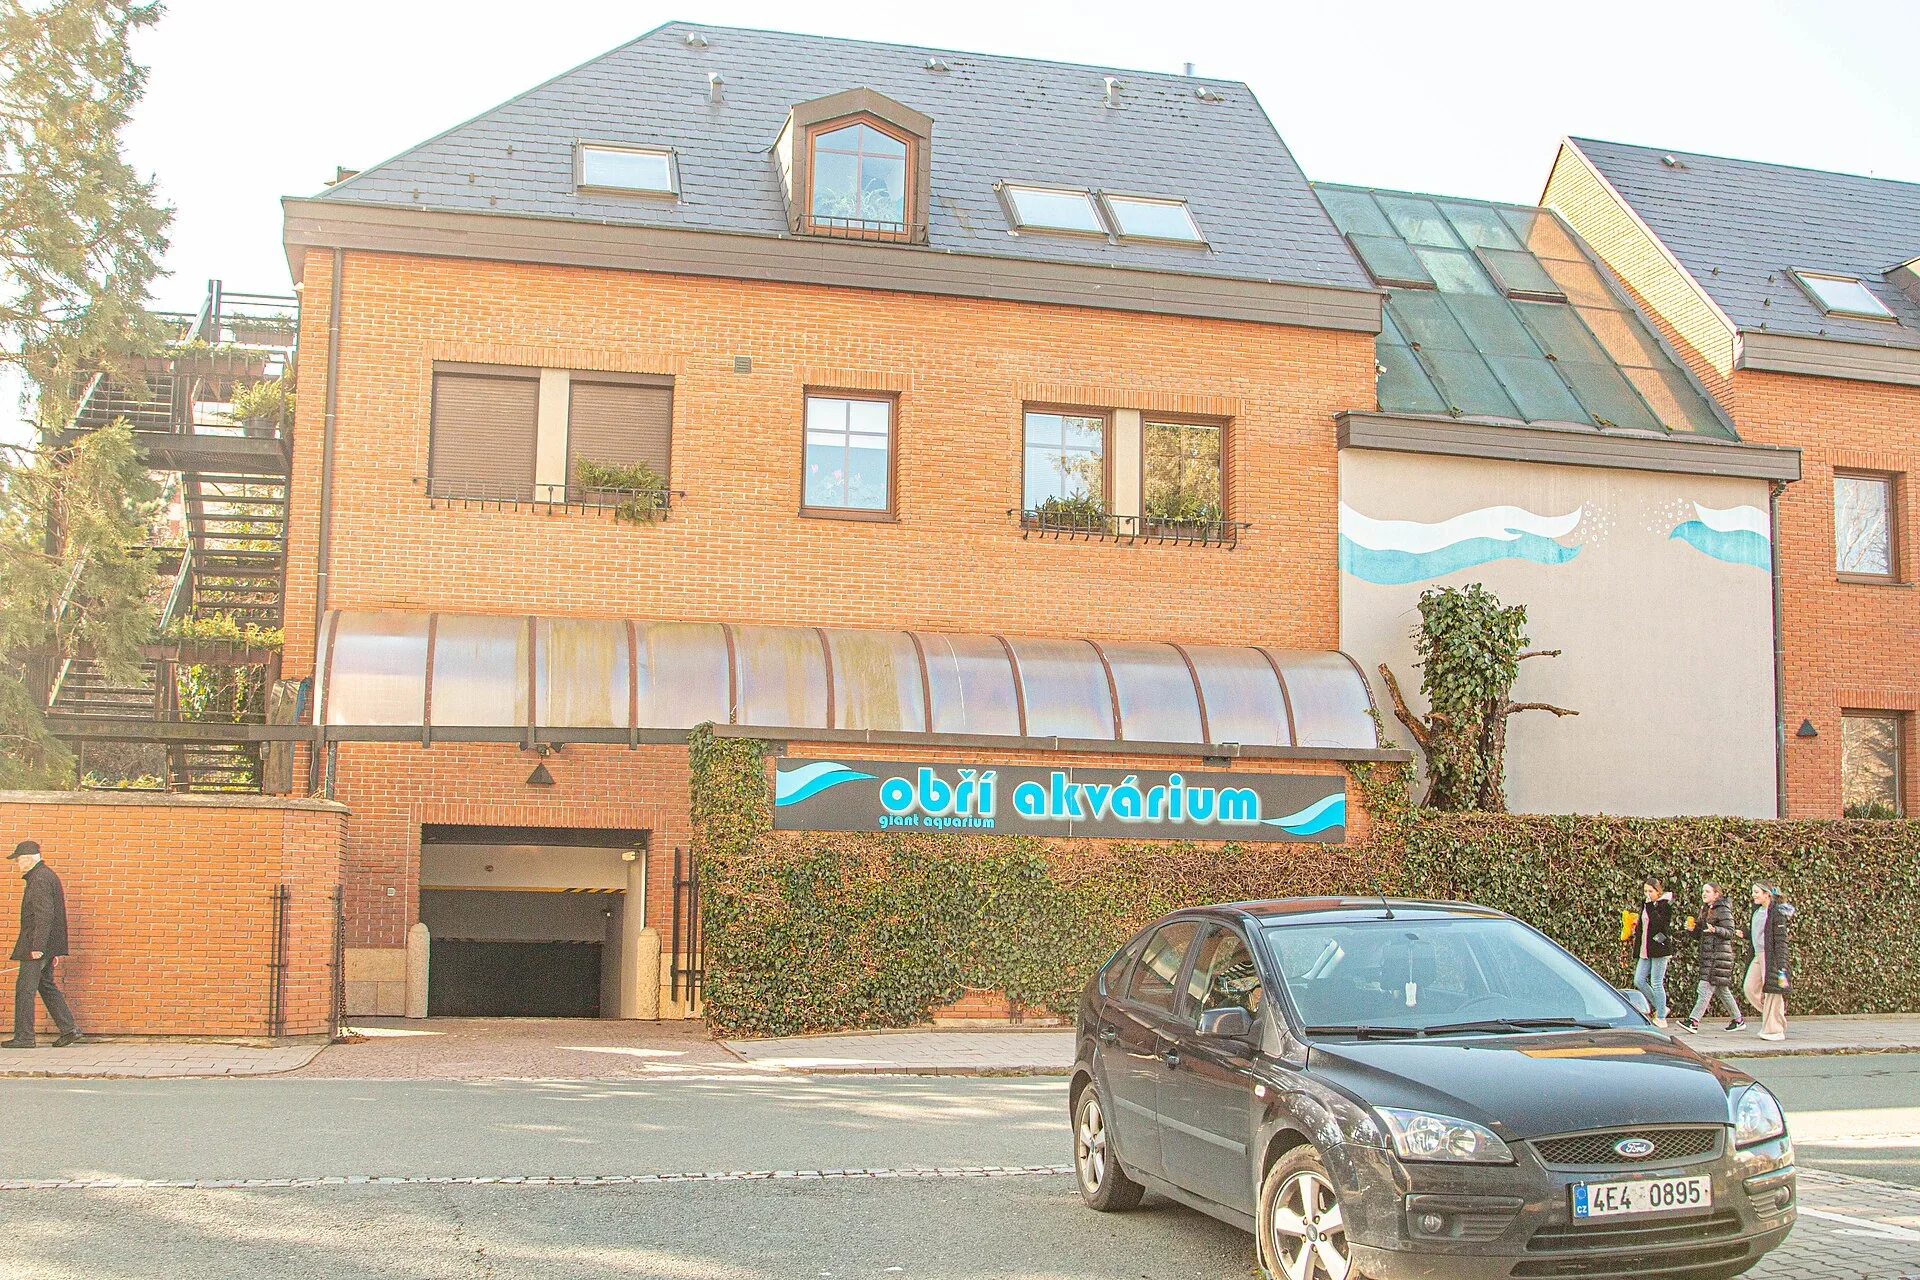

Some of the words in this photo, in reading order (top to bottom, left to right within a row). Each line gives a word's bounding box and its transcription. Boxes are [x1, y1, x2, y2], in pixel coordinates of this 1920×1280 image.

[880, 767, 996, 815] obří
[1013, 772, 1259, 822] akvárium
[878, 813, 920, 829] giant
[923, 815, 996, 830] aquarium
[1625, 1142, 1647, 1153] Ford
[1593, 1186, 1632, 1212] 4E4
[1649, 1180, 1701, 1207] 0895
[1576, 1205, 1588, 1214] CZ
